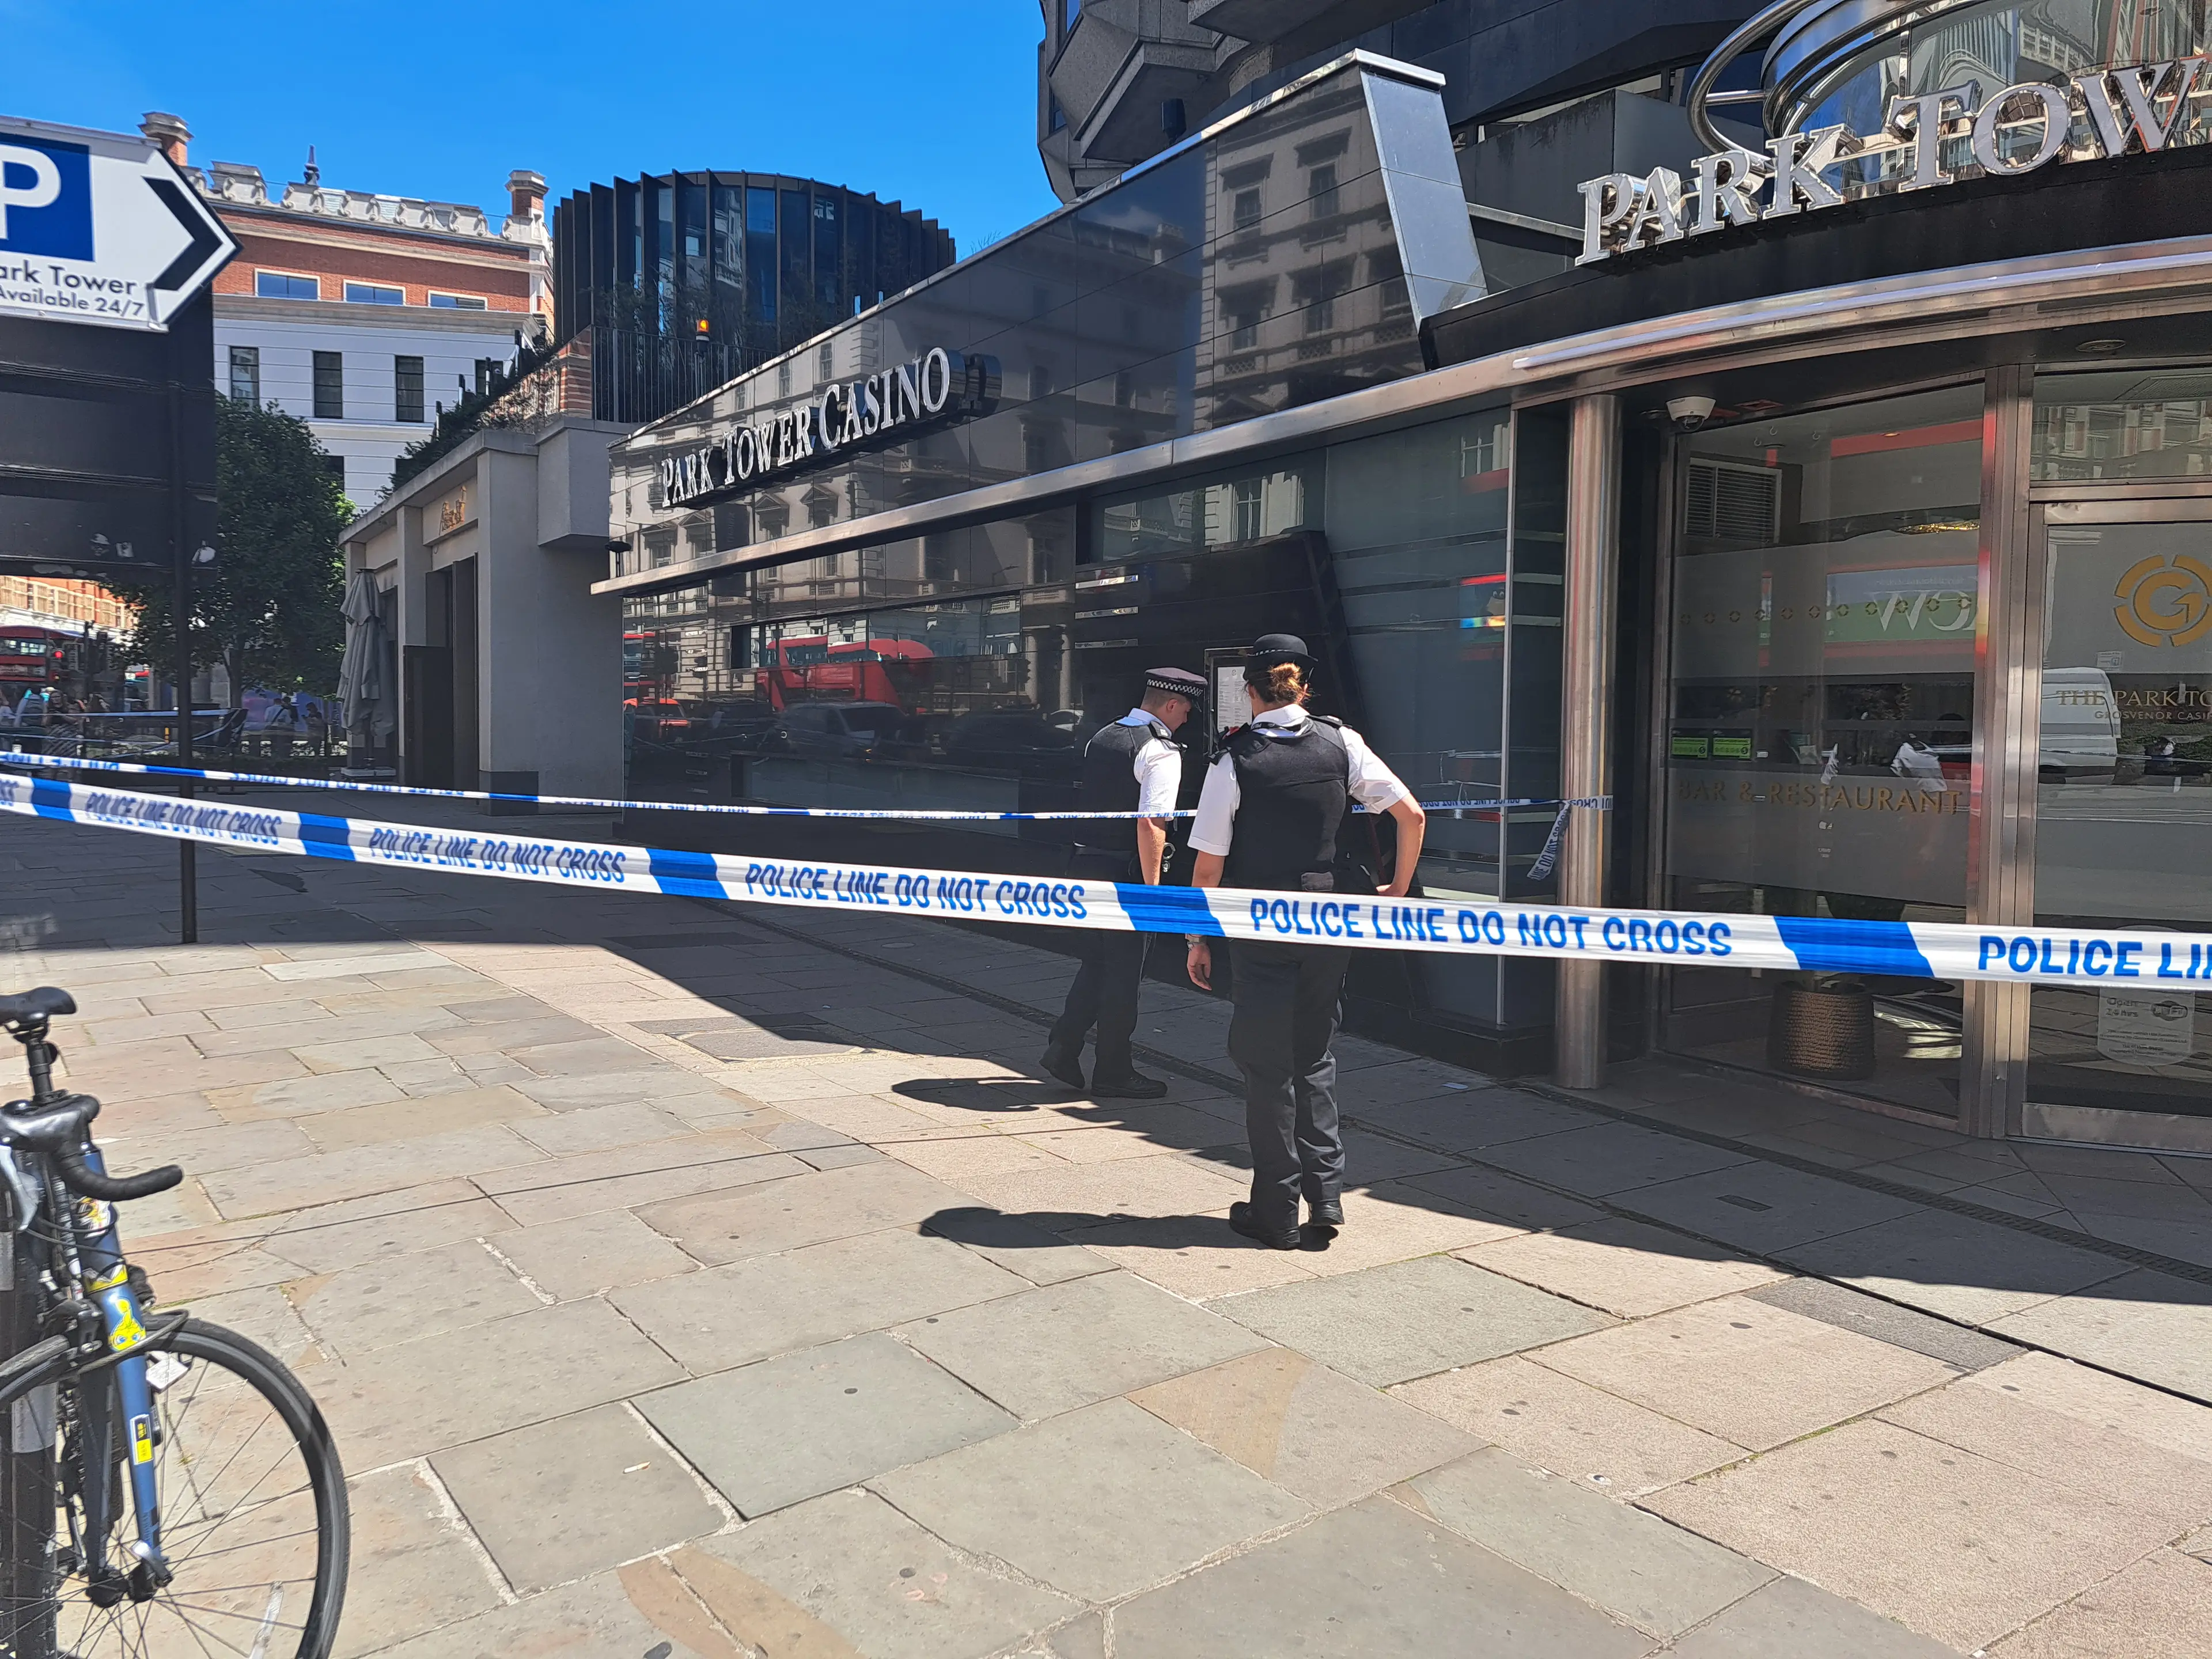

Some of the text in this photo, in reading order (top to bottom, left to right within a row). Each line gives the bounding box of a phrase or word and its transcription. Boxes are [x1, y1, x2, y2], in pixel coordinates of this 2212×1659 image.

[1575, 55, 2209, 266] PARK TOW
[0, 145, 61, 240] P
[48, 265, 137, 295] Tower
[95, 297, 144, 317] 24/7
[662, 347, 951, 507] PARK TOWER CASINO
[2056, 690, 2105, 706] THE
[2113, 690, 2178, 707] PARK
[2094, 710, 2171, 720] GROSVENOR
[86, 792, 282, 845] POLICE LINE DO NOT CROSS
[1678, 780, 1962, 816] BAR & RESTAURANT
[369, 827, 627, 883] POLICE LINE DO NOT CROSS
[745, 863, 1088, 920] POLICE LINE DO NOT CROSS
[1251, 898, 1733, 957] POLICE LINE DO NOT CROSS
[1978, 935, 2143, 977] POLICE
[2106, 997, 2138, 1008] Open
